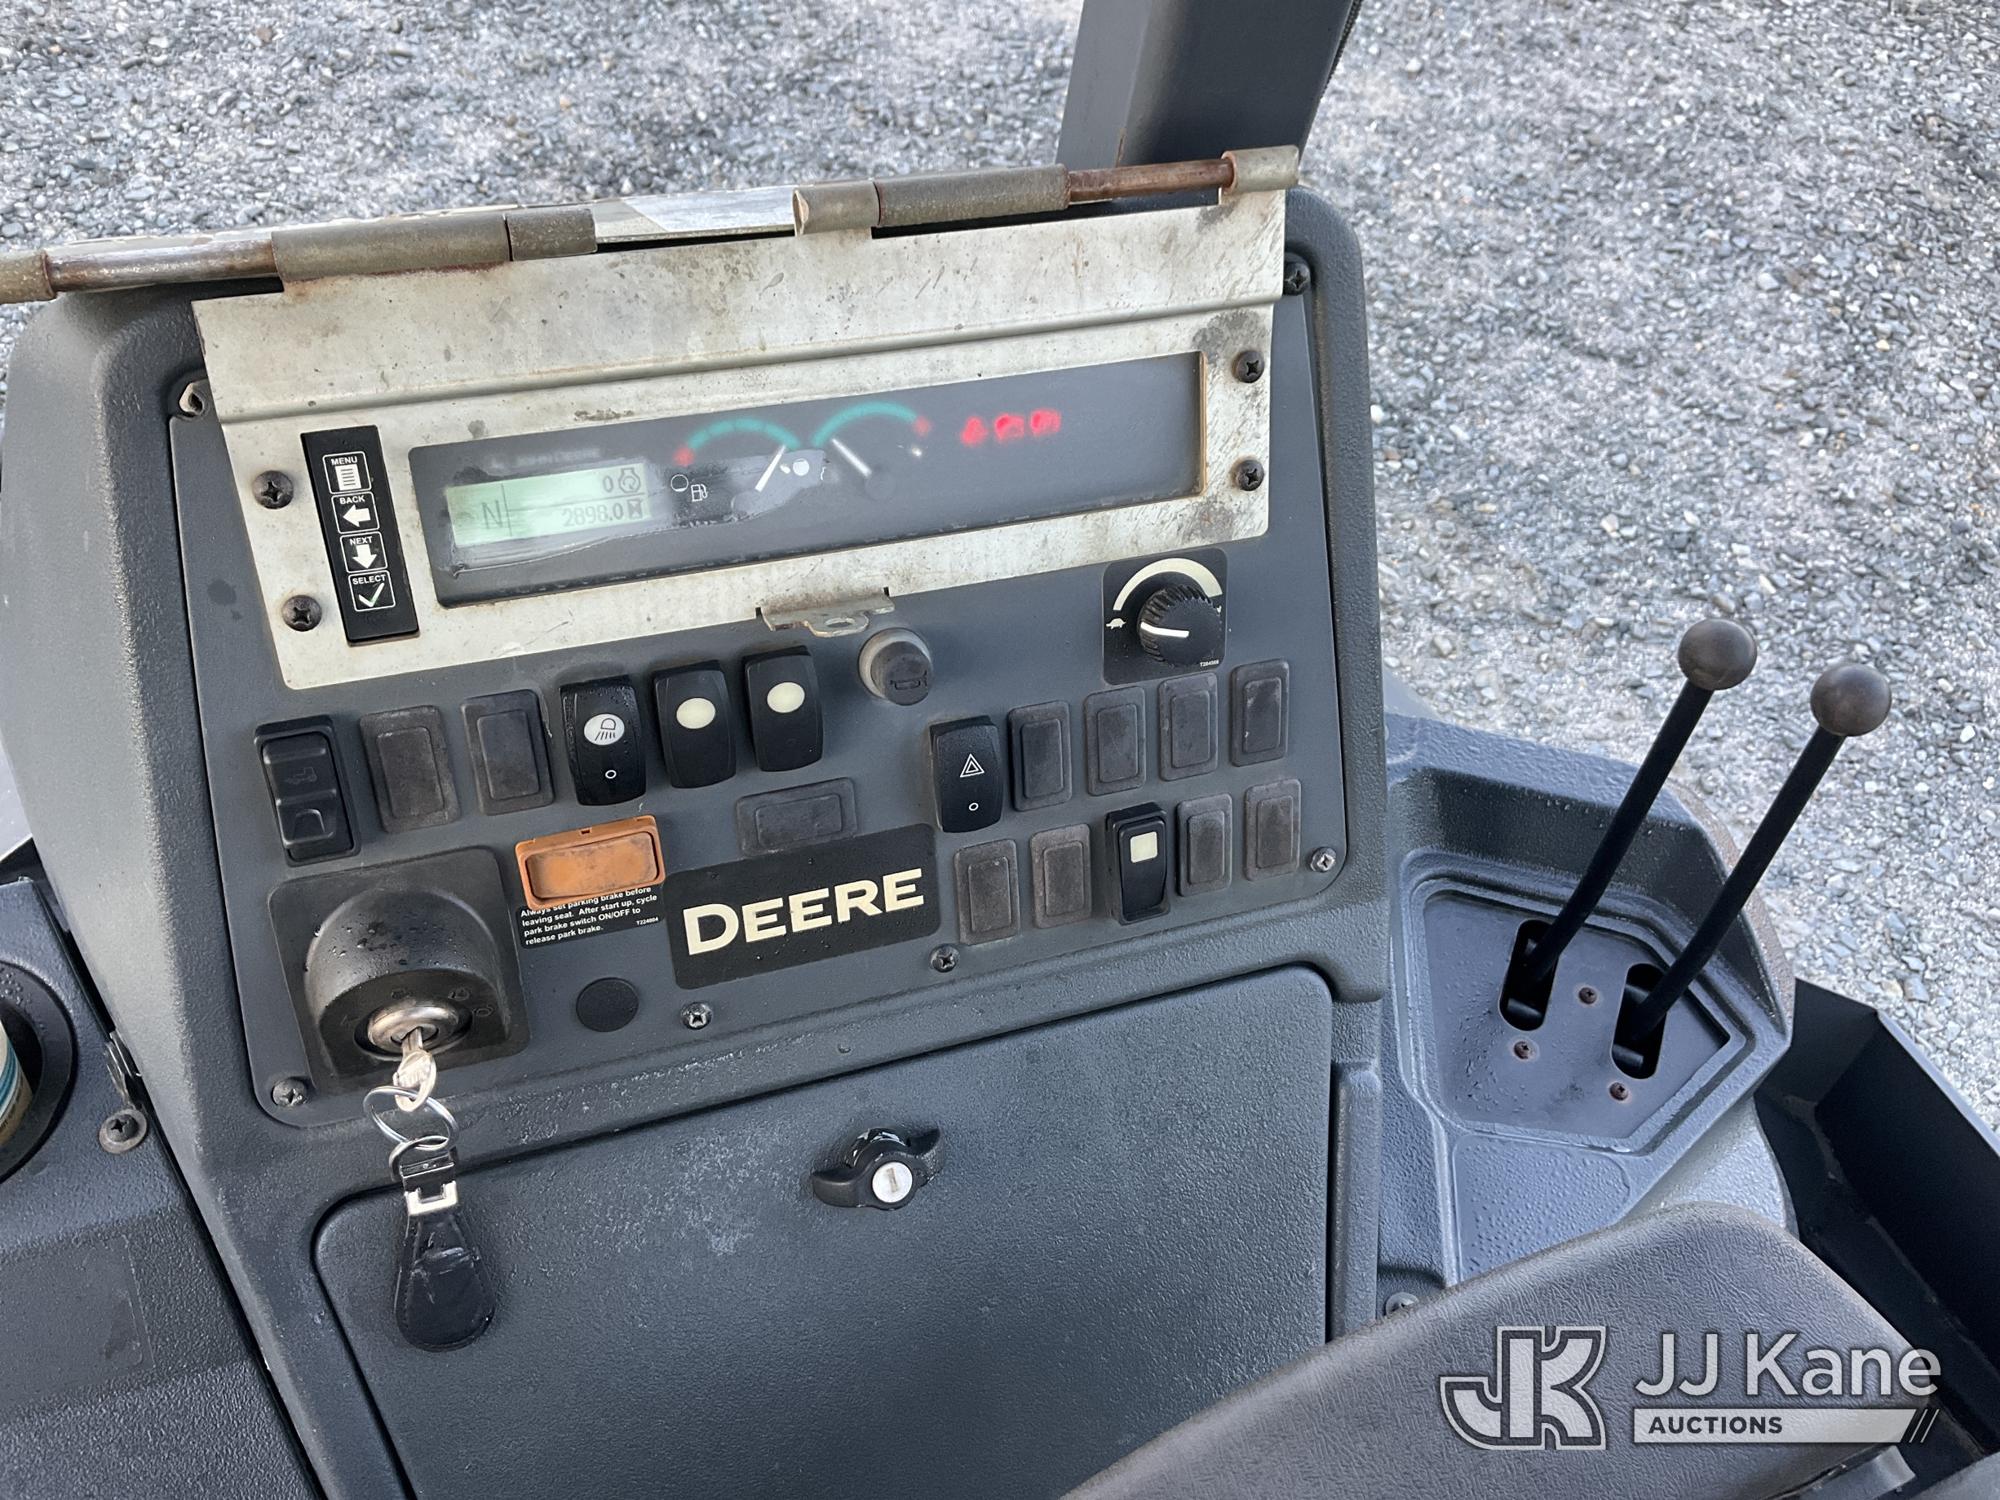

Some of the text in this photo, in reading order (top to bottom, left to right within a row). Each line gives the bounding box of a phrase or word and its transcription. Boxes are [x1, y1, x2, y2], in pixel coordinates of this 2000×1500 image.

[331, 456, 358, 466] MENU
[340, 495, 366, 505] BACK
[482, 500, 501, 529] N
[562, 503, 625, 527] 2898.0
[350, 536, 373, 545] NEXT
[352, 574, 386, 585] SELECT
[568, 897, 599, 909] parking
[600, 892, 623, 901] brake
[625, 887, 652, 896] before
[522, 915, 553, 926] leaving
[554, 911, 574, 920] seat.
[579, 907, 599, 915] After
[601, 902, 620, 911] start
[636, 895, 658, 904] cycle
[683, 868, 924, 955] DEERE
[524, 927, 543, 937] park
[544, 922, 568, 932] brake
[570, 916, 597, 927] switch
[598, 909, 630, 921] ON/OFF
[525, 924, 604, 945] release park brake.
